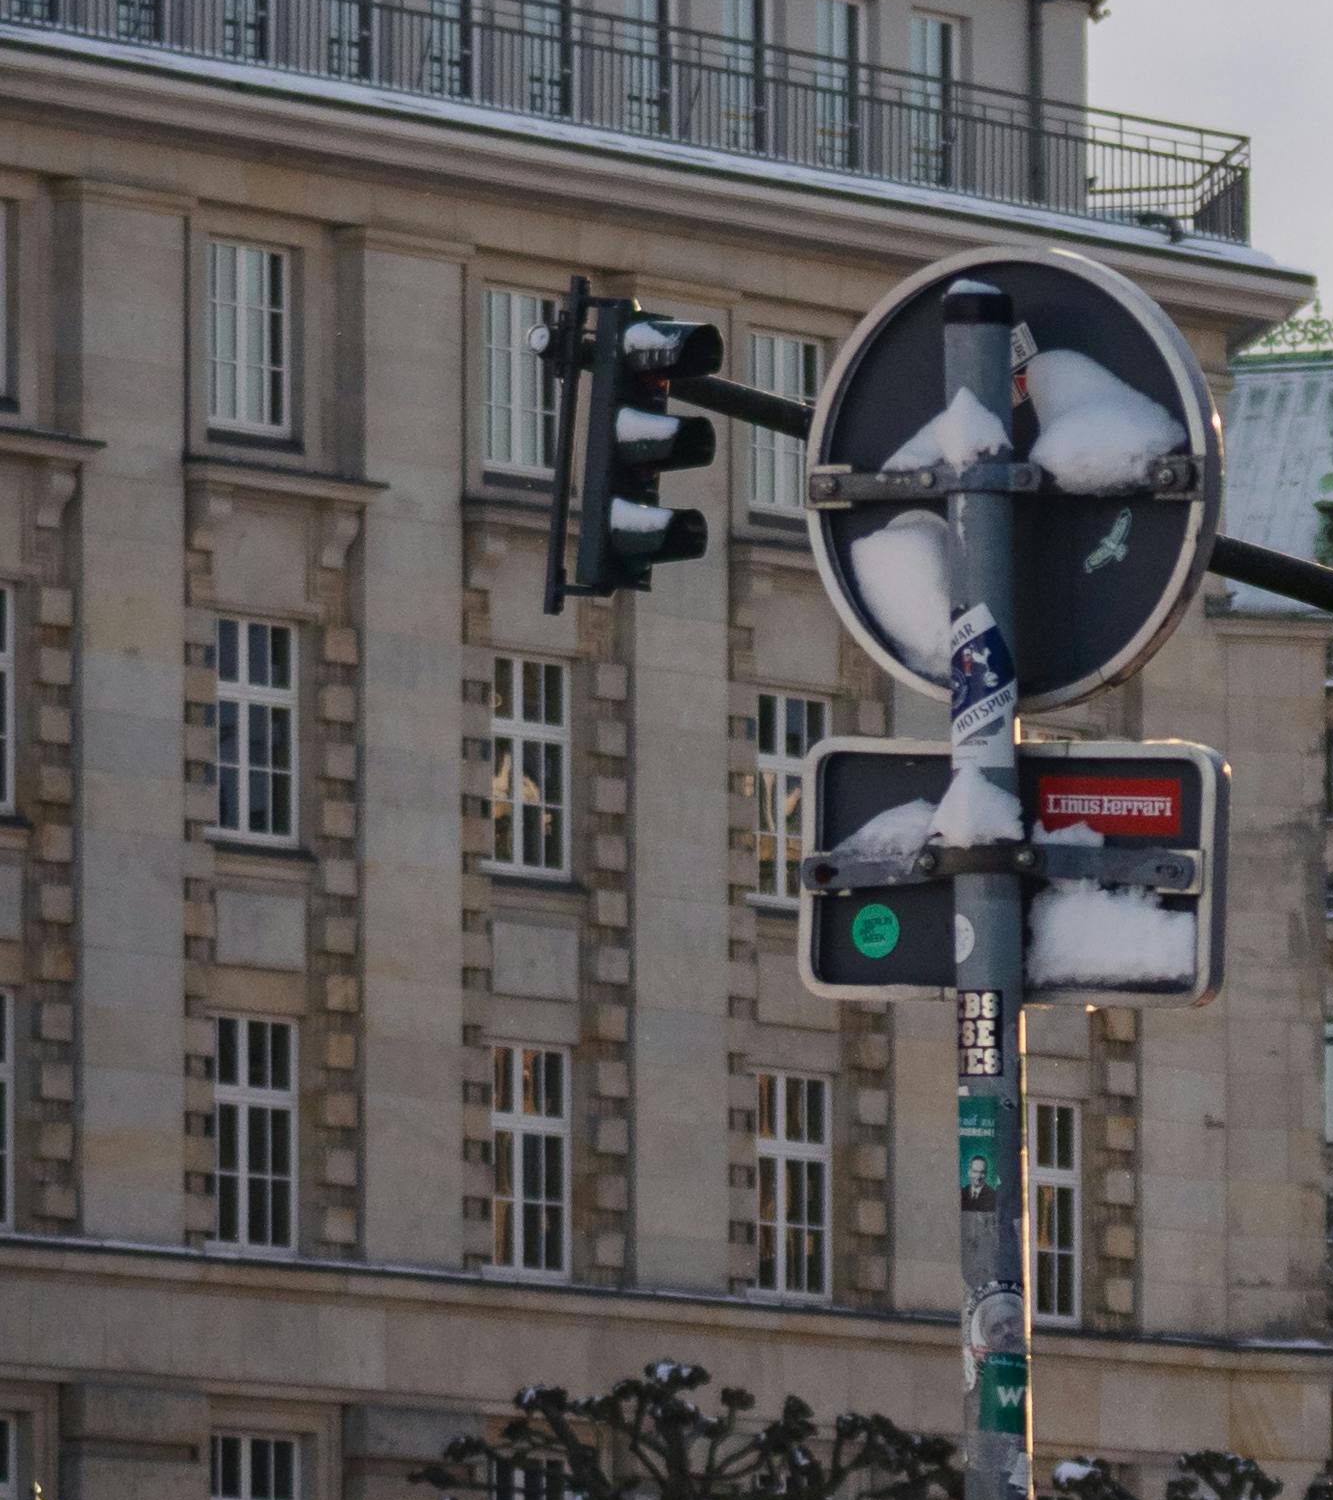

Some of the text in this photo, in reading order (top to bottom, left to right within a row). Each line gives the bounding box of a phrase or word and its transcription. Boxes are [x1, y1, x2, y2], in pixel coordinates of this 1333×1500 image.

[955, 688, 1014, 734] HOTSPUR
[1046, 794, 1172, 817] Linus Ferrari
[996, 1385, 1028, 1408] W
